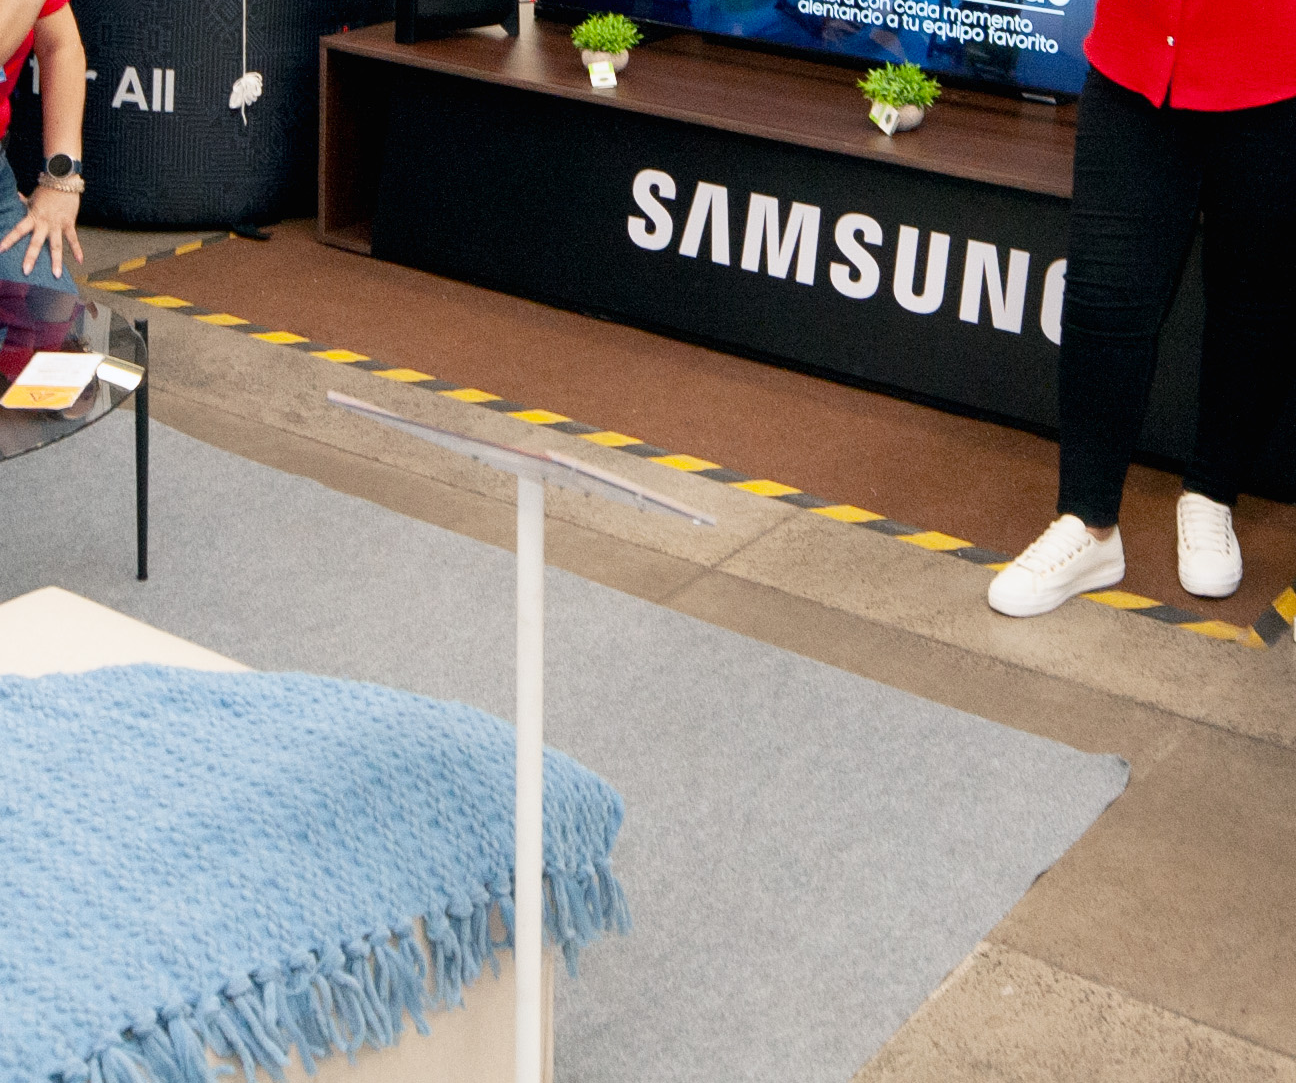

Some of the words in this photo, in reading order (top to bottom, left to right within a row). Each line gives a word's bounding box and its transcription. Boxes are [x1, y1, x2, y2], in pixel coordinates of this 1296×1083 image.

[886, 14, 899, 29] a
[902, 11, 920, 32] tu
[922, 19, 985, 44] equipo
[986, 27, 1059, 55] favorito
[943, 5, 1033, 35] momento
[111, 66, 175, 113] All
